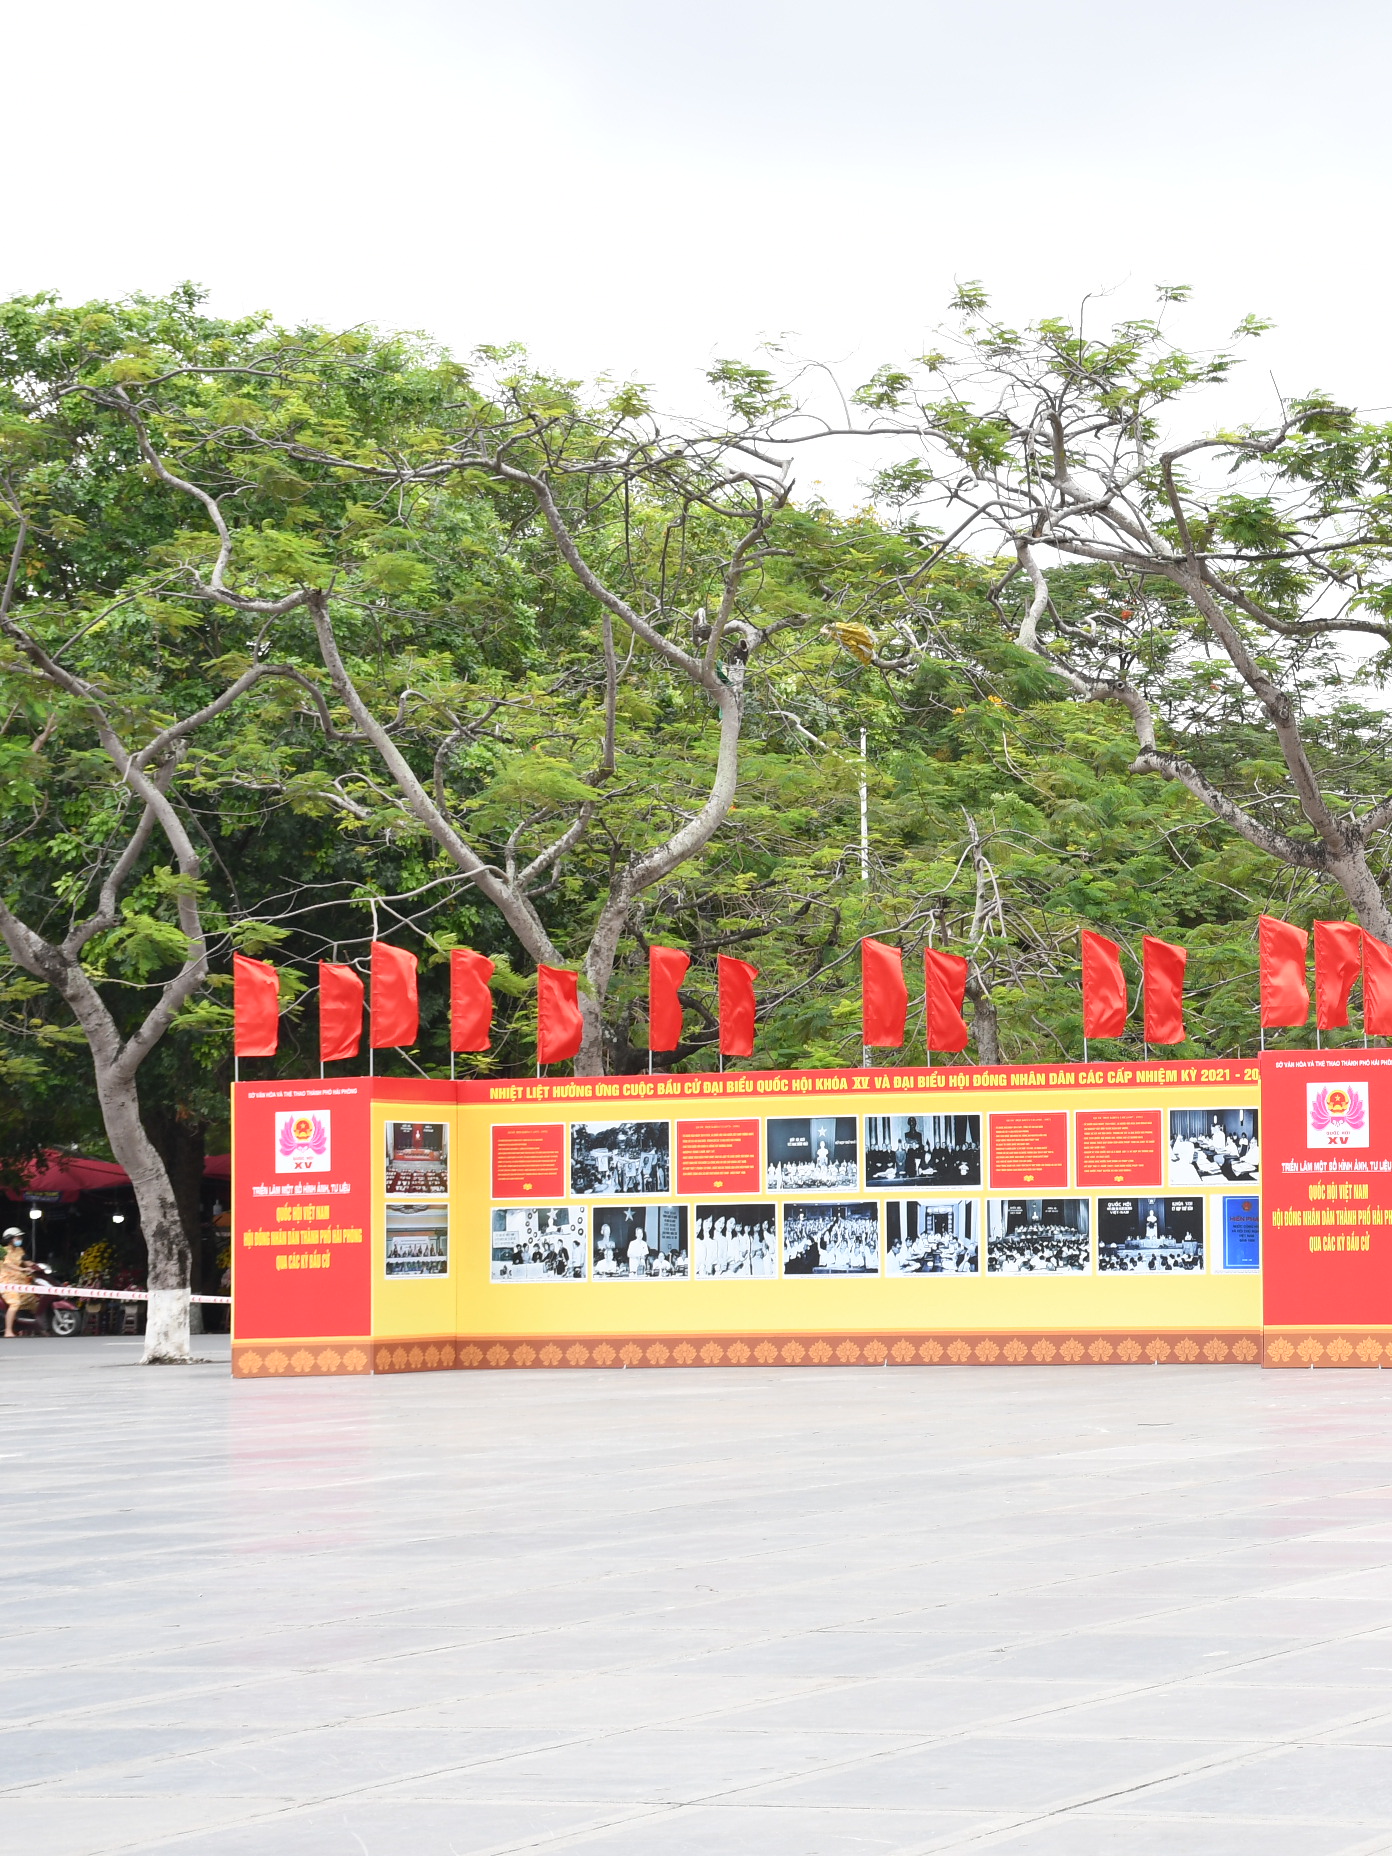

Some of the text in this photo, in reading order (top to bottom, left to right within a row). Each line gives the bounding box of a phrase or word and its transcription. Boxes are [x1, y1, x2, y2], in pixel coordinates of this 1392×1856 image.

[490, 1085, 523, 1101] NHIỆT
[526, 1084, 549, 1100] LIỆT
[553, 1082, 592, 1097] HƯỞNG
[596, 1082, 619, 1096] ỨNG
[623, 1082, 654, 1097] CUỘC
[684, 1078, 701, 1094] CỬ
[703, 1080, 722, 1095] ĐẠI
[726, 1076, 751, 1092] BIỂU
[757, 1076, 788, 1093] QUỐC
[792, 1077, 812, 1093] HỘI
[816, 1076, 848, 1090] KHÓA
[852, 1077, 870, 1089] XV
[875, 1074, 890, 1088] VÀ
[894, 1076, 914, 1090] ĐẠI
[918, 1071, 945, 1088] BIỂU
[949, 1073, 969, 1090] HỘI
[1011, 1071, 1045, 1086] NHÂN
[1049, 1070, 1075, 1085] DÂN
[1079, 1068, 1103, 1083] CÁC
[1108, 1067, 1132, 1083] CẤP
[1136, 1068, 1177, 1085] NHIỆM
[1181, 1067, 1197, 1082] KỲ
[1201, 1069, 1230, 1082] 2021
[1309, 1179, 1368, 1203] QUỐC HỘI VIỆT NAM
[1272, 1208, 1283, 1230] HỘI
[1303, 1208, 1320, 1226] NHÂN
[1322, 1207, 1334, 1225] DÂN
[1336, 1207, 1356, 1225] THÀNH
[1358, 1205, 1371, 1225] PHỐ
[1372, 1205, 1383, 1225] HẢI
[1309, 1236, 1321, 1253] QUA
[1323, 1233, 1336, 1252] CÁC
[1337, 1233, 1345, 1251] KỲ
[1360, 1231, 1370, 1251] CỬ
